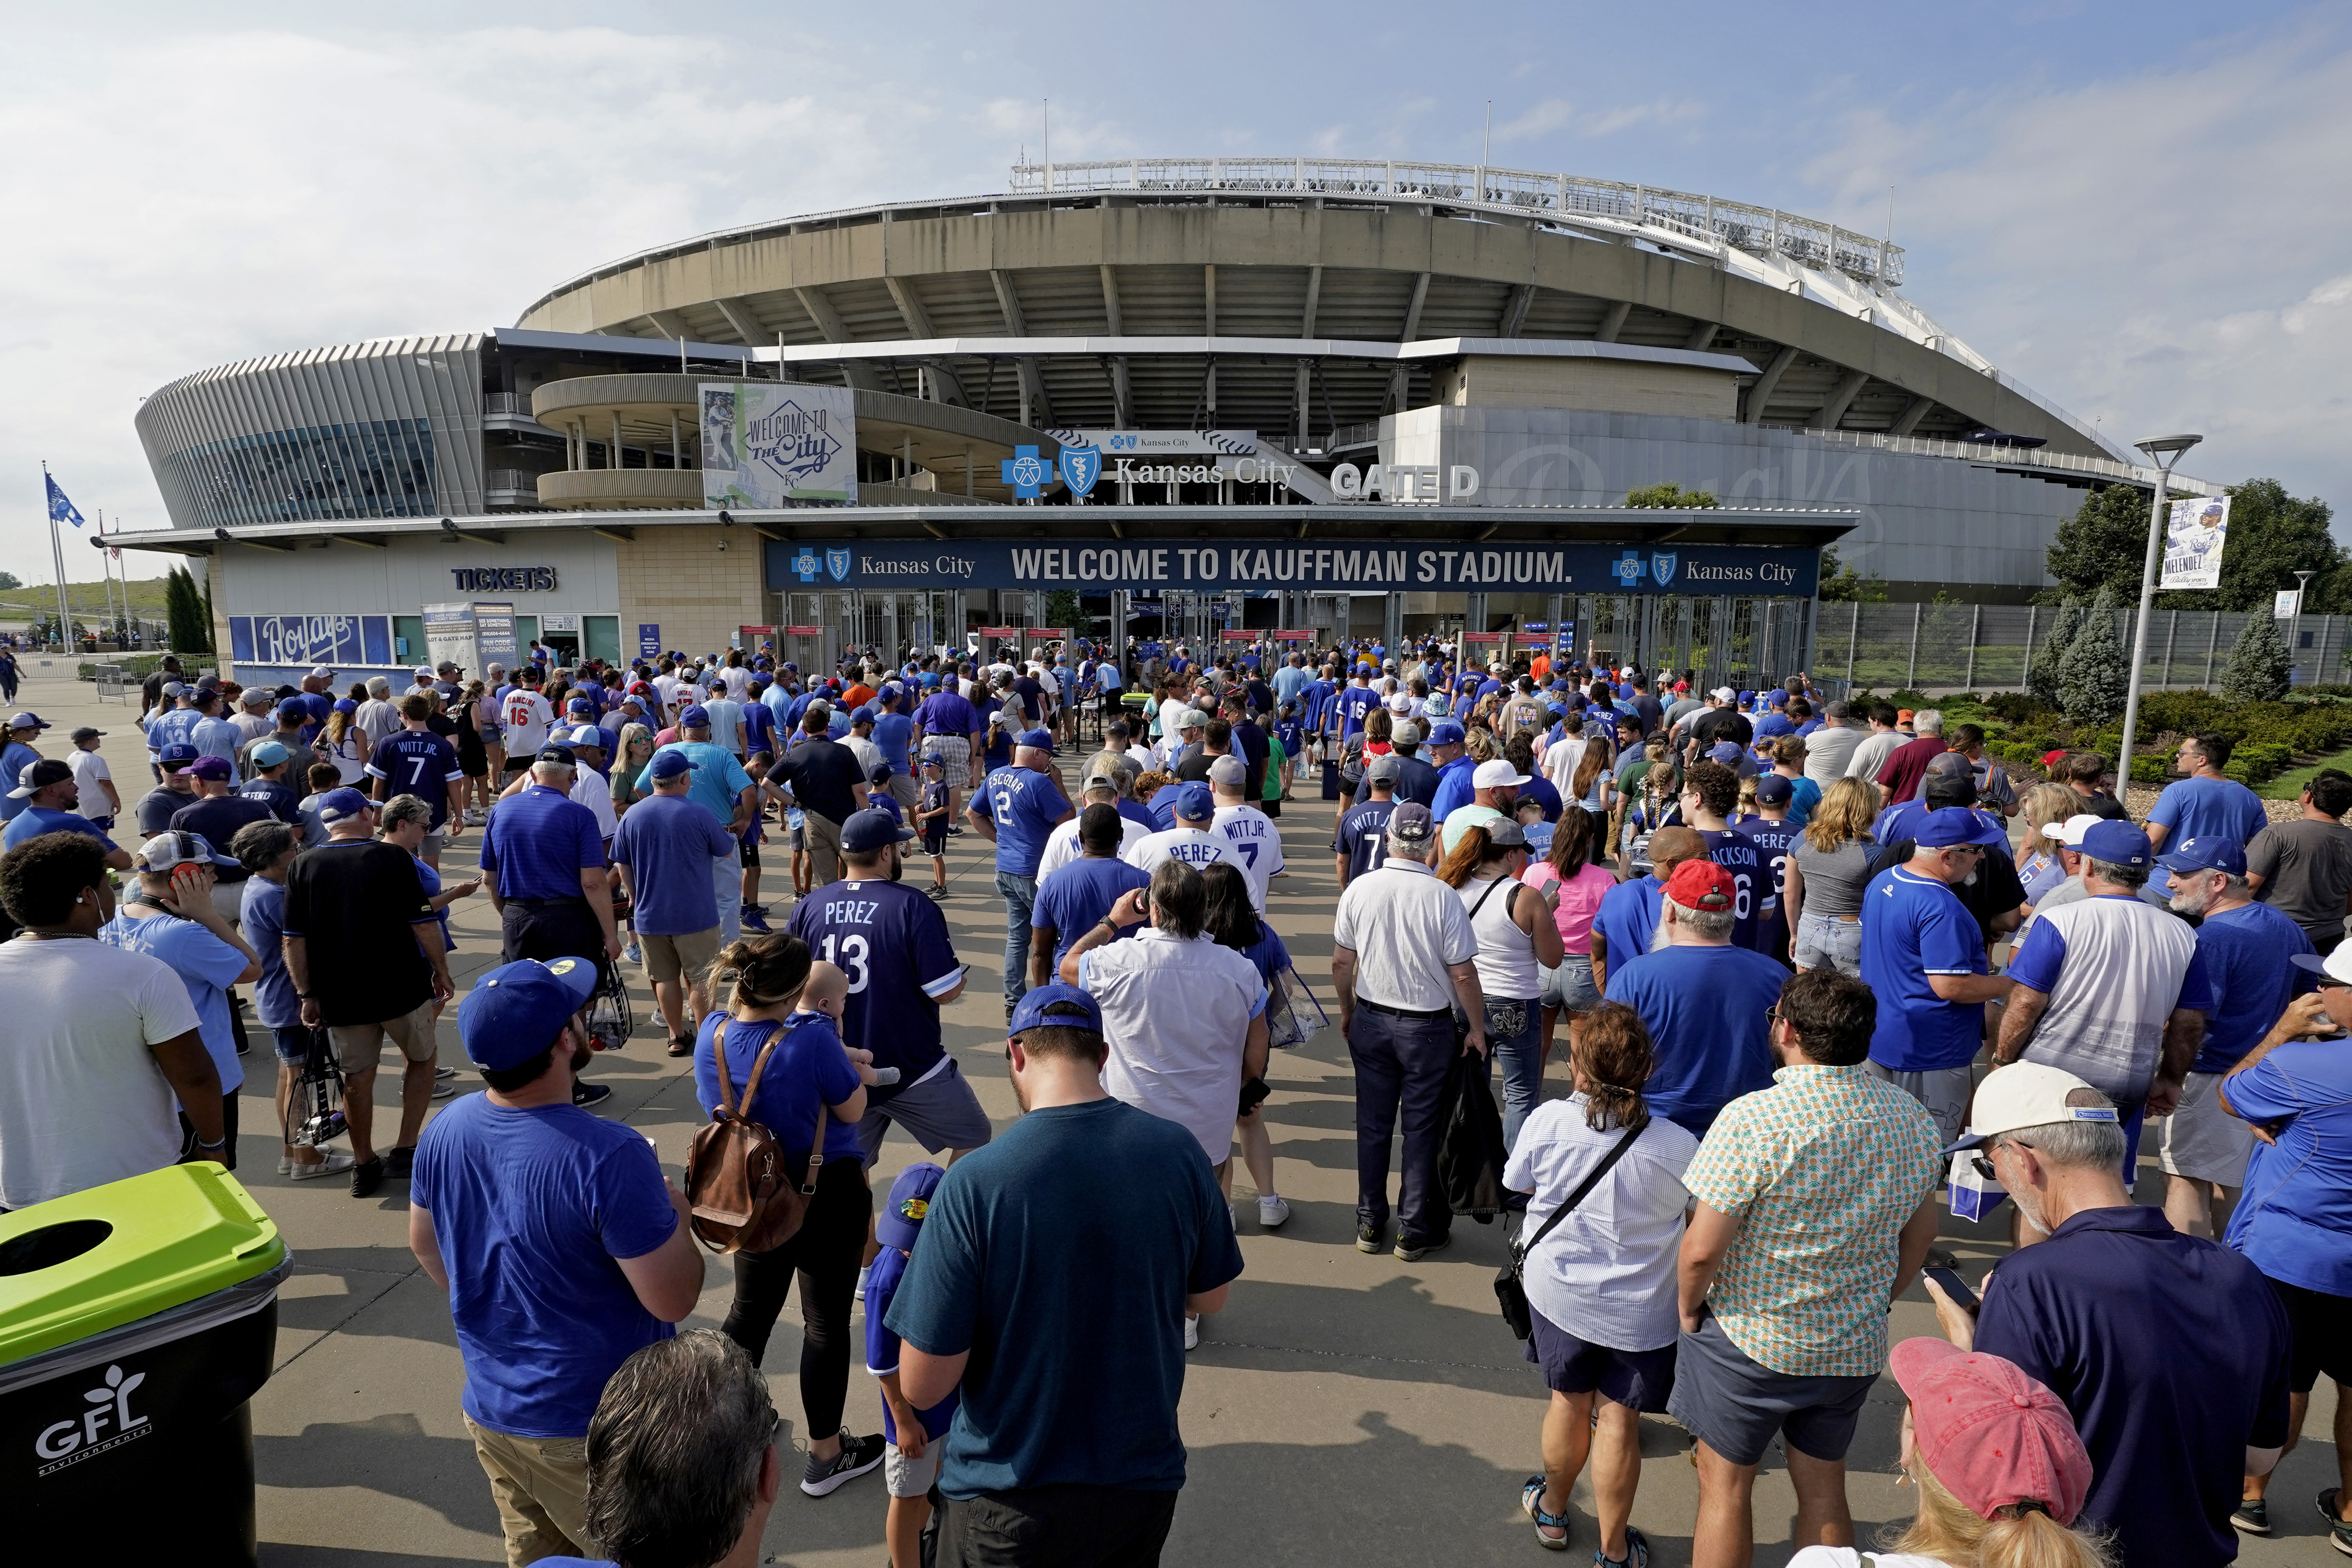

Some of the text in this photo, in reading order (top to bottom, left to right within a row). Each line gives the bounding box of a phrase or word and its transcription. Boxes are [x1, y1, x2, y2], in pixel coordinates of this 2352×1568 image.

[750, 409, 826, 443] WELCOME TO
[751, 432, 831, 473] THE City
[1141, 438, 1190, 448] Kansas City
[784, 474, 799, 489] KC
[1114, 457, 1298, 490] Kansas City
[1330, 464, 1480, 500] GATE D
[860, 555, 976, 578] Kansas City
[1011, 548, 1572, 584] WELCOME TO KAUFFMAN STADIUM.
[1685, 561, 1797, 585] Kansas City
[2165, 555, 2202, 575] MELENDEZ
[451, 566, 554, 591] TICKETS
[2170, 576, 2191, 584] Bally
[508, 697, 536, 707] MANCINI
[1351, 701, 1366, 720] 16
[1614, 706, 1631, 714] EREZ
[161, 716, 189, 728] PEREZ
[510, 707, 528, 726] 16
[1593, 712, 1614, 721] PEREZ
[1284, 729, 1291, 741] 7
[398, 741, 437, 755] WITT JR.
[407, 757, 425, 785] 7
[988, 774, 1024, 794] ESCOBAR
[995, 791, 1012, 825] 2
[1224, 820, 1267, 840] WITT JR.
[1352, 811, 1380, 832] WITT
[1169, 843, 1222, 863] PEREZ
[1238, 843, 1258, 871] 7
[1364, 834, 1380, 870] 7
[1708, 846, 1757, 867] ACKSON
[825, 900, 879, 926] PEREZ
[821, 933, 869, 994] 13
[36, 1372, 149, 1459] GFL
[39, 1425, 152, 1475] environmental
